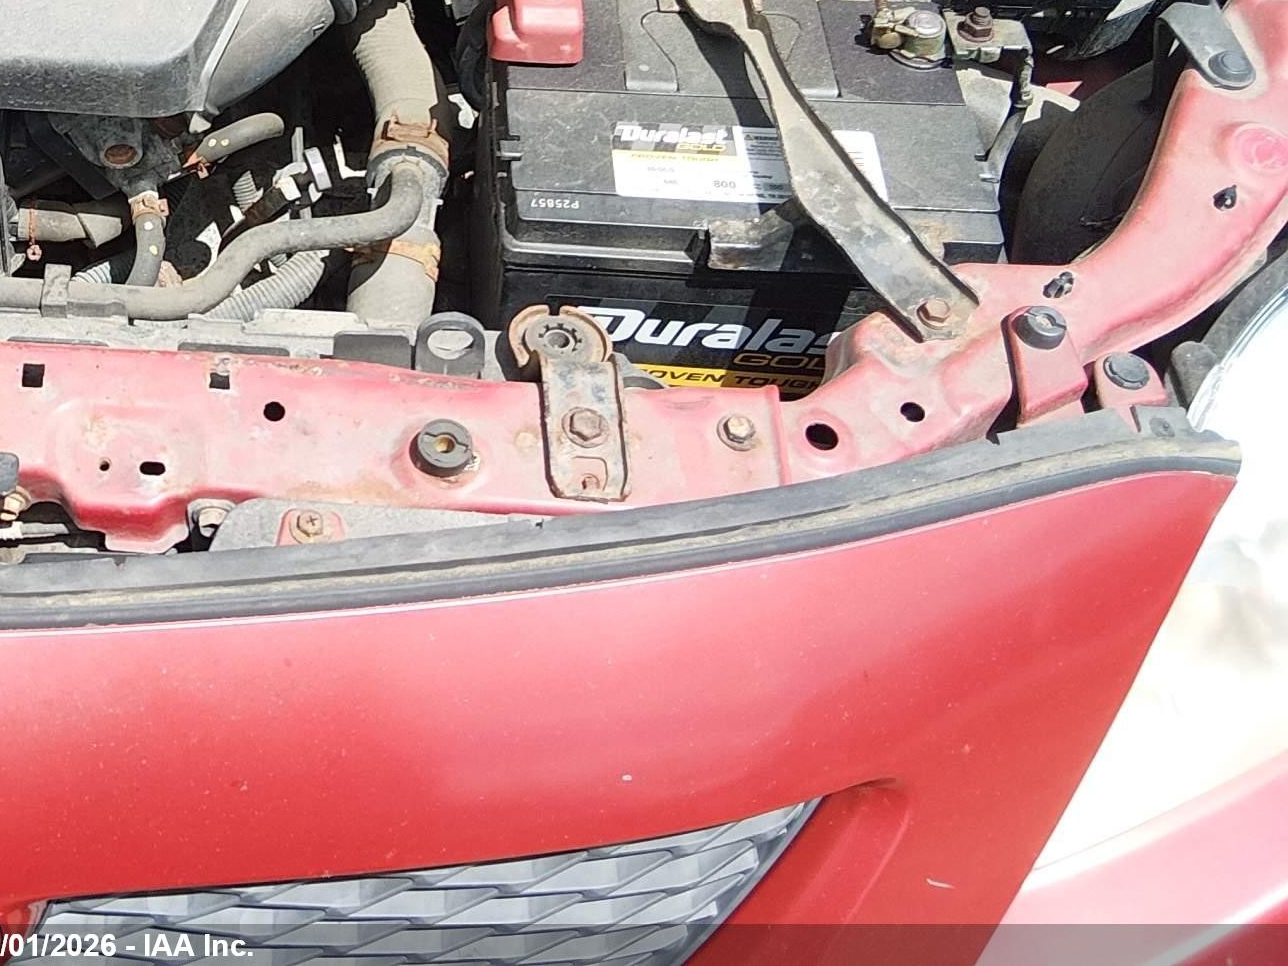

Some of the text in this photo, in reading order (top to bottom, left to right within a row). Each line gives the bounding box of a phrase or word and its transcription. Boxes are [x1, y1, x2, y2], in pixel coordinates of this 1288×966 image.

[614, 124, 729, 144] Duralast
[675, 142, 727, 153] GOLD
[713, 180, 737, 190] 800
[530, 198, 580, 210] P25857
[638, 368, 725, 383] OVEN
